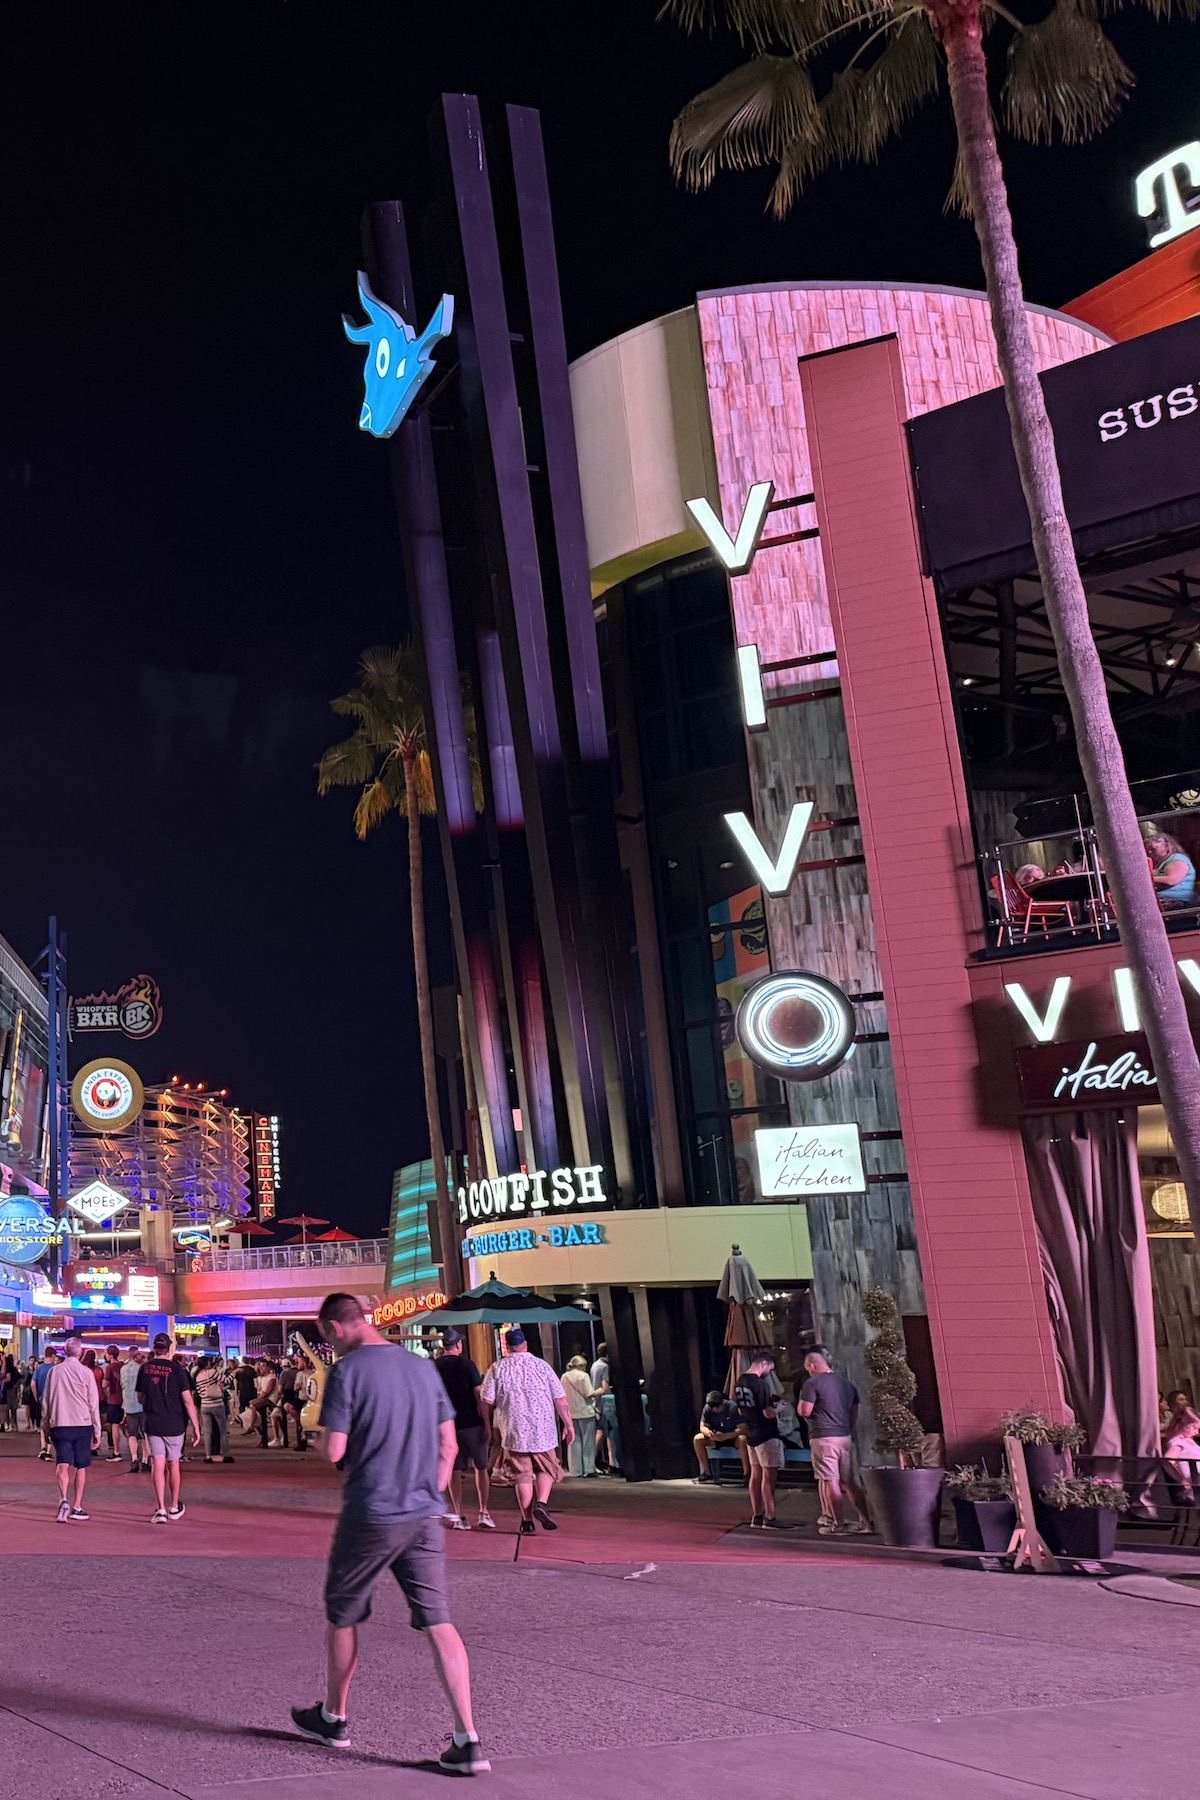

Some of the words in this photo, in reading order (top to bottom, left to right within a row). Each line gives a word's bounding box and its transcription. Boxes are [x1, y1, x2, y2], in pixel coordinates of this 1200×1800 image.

[1098, 381, 1200, 443] SUS
[76, 1005, 118, 1013] WHOPPER
[77, 1012, 119, 1027] BAR
[125, 1004, 150, 1027] BK
[84, 1073, 102, 1094] PANDA
[104, 1071, 130, 1094] EXPRESS
[1053, 1042, 1158, 1099] italia
[271, 1115, 281, 1189] UNIVERSAL
[775, 1131, 844, 1163] italian
[259, 1117, 272, 1217] CINEMARK
[774, 1164, 852, 1189] kitchen
[469, 1164, 608, 1218] COWFISH
[27, 1235, 64, 1245] STORE
[474, 1228, 533, 1256] BURGER
[548, 1223, 603, 1247] BAR
[83, 1281, 115, 1290] WORLD
[373, 1297, 417, 1325] FOOD
